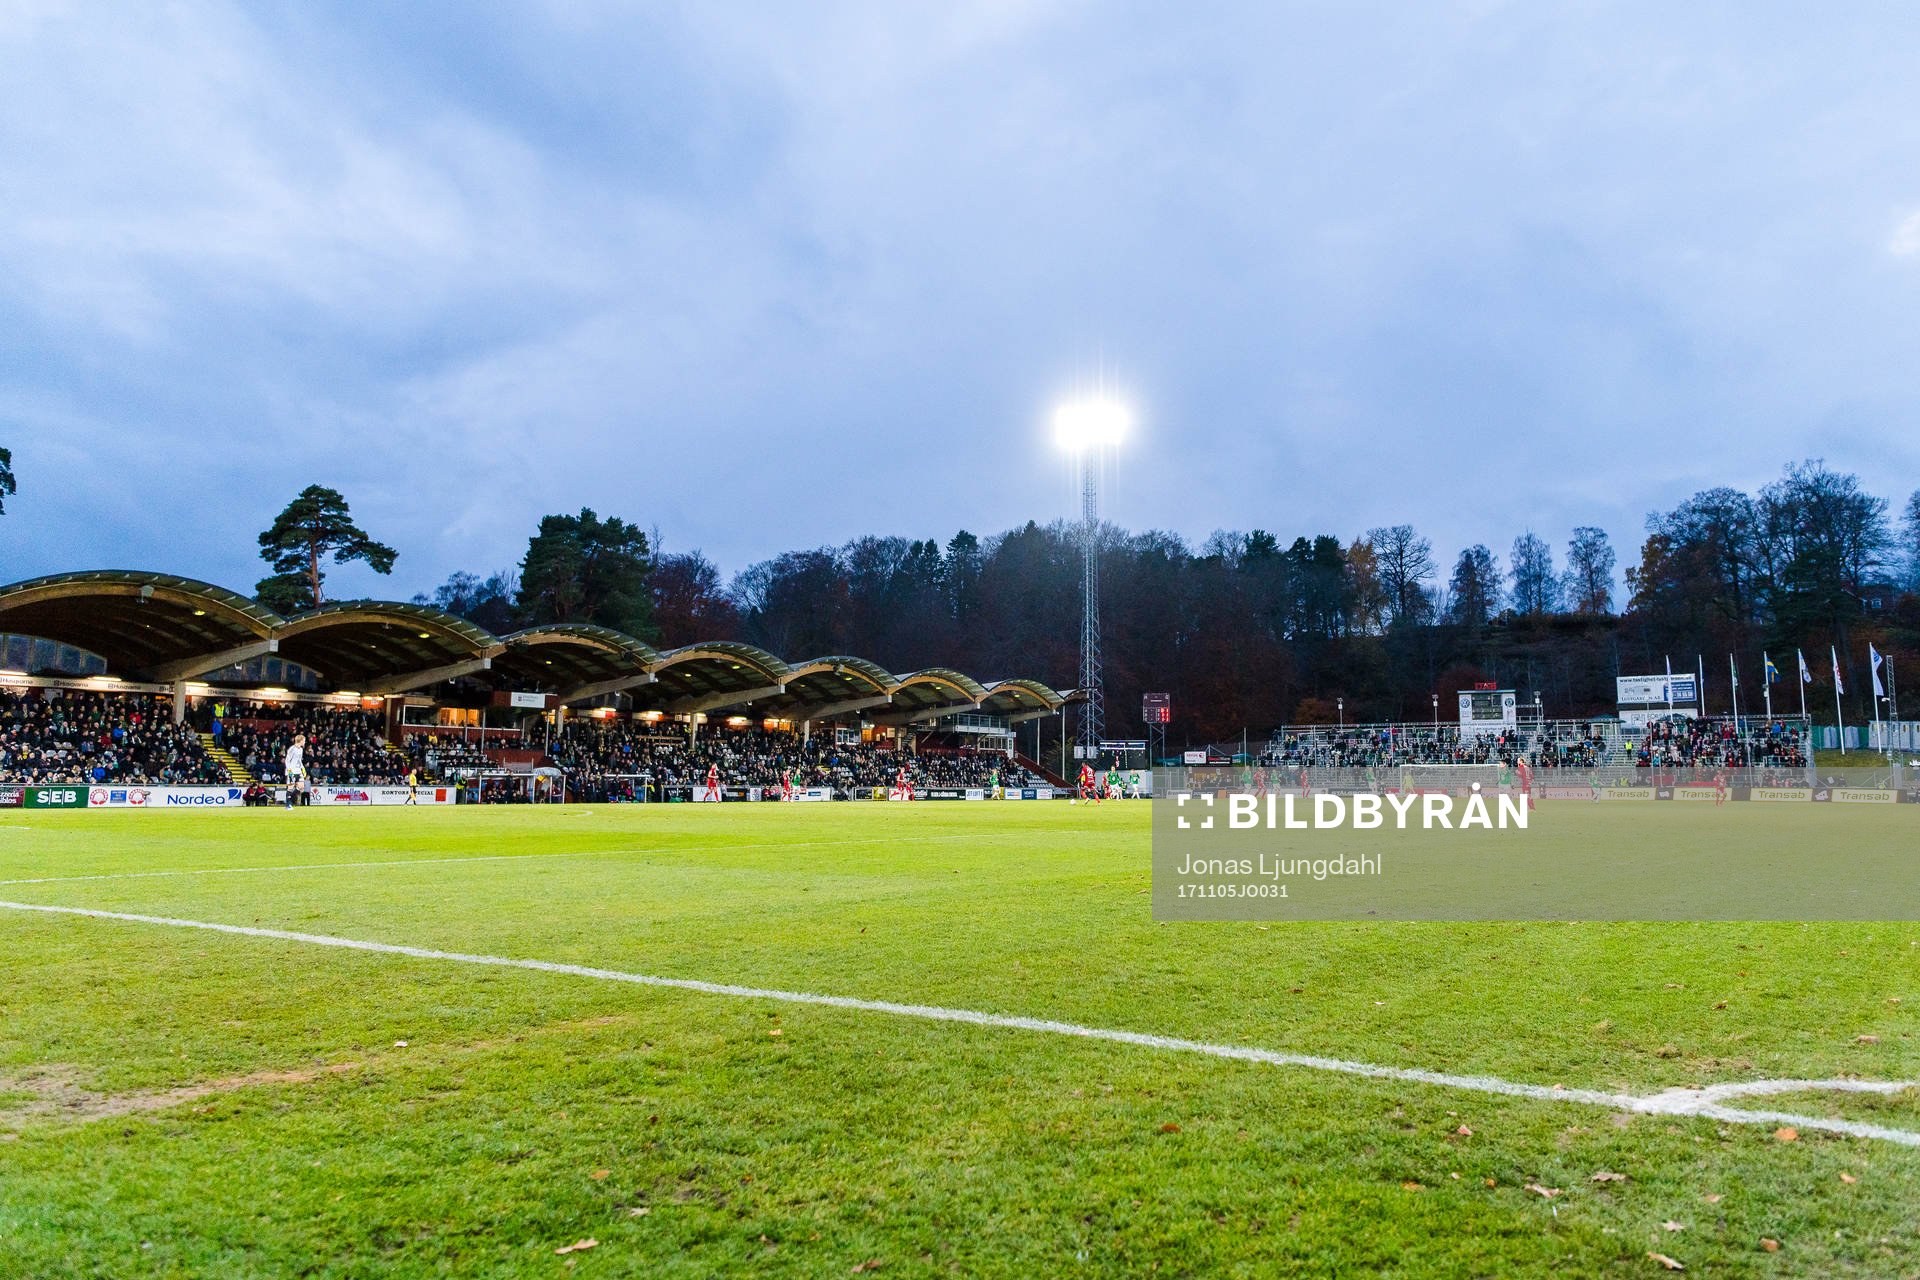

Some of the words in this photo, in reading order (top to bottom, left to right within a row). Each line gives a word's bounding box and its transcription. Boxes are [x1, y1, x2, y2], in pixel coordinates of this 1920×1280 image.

[1607, 790, 1650, 798] Transab
[1758, 790, 1805, 799] Transab
[1840, 791, 1890, 801] Transab
[167, 793, 226, 805] Nordea
